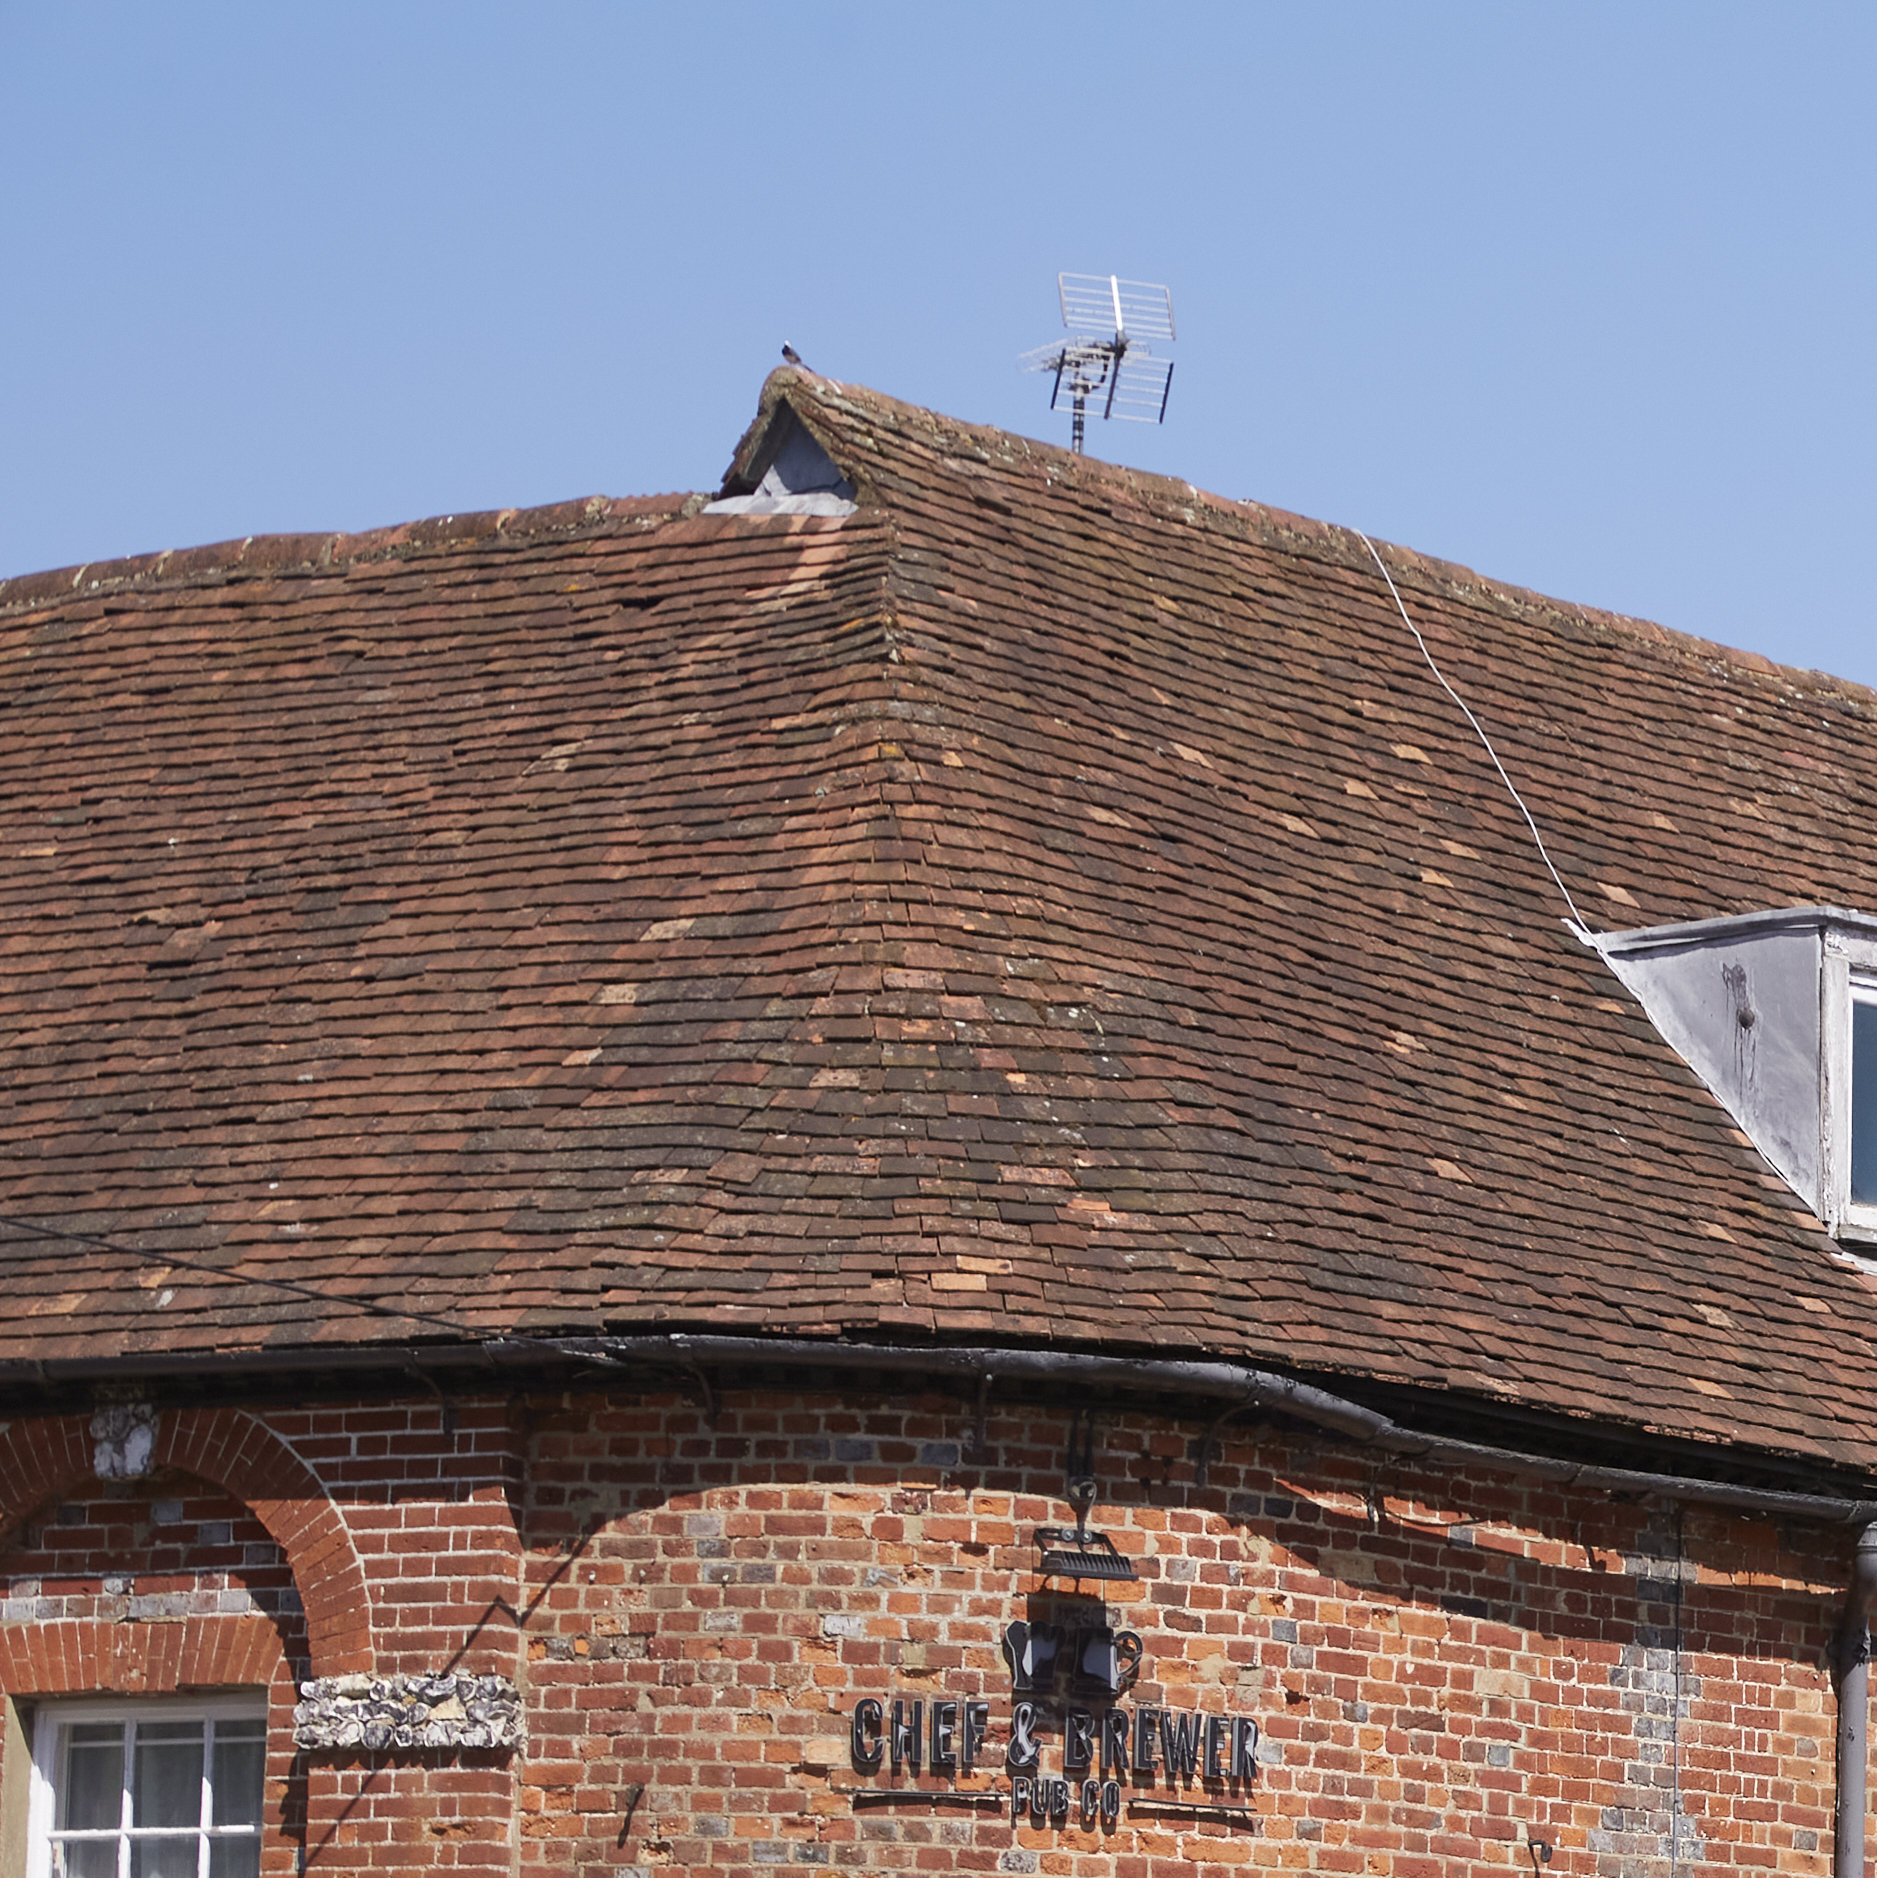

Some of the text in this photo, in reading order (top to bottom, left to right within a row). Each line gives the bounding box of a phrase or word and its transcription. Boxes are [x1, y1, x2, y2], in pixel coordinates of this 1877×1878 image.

[851, 1698, 1259, 1778] CHEF & BREWER
[1012, 1776, 1121, 1818] PUB CO
